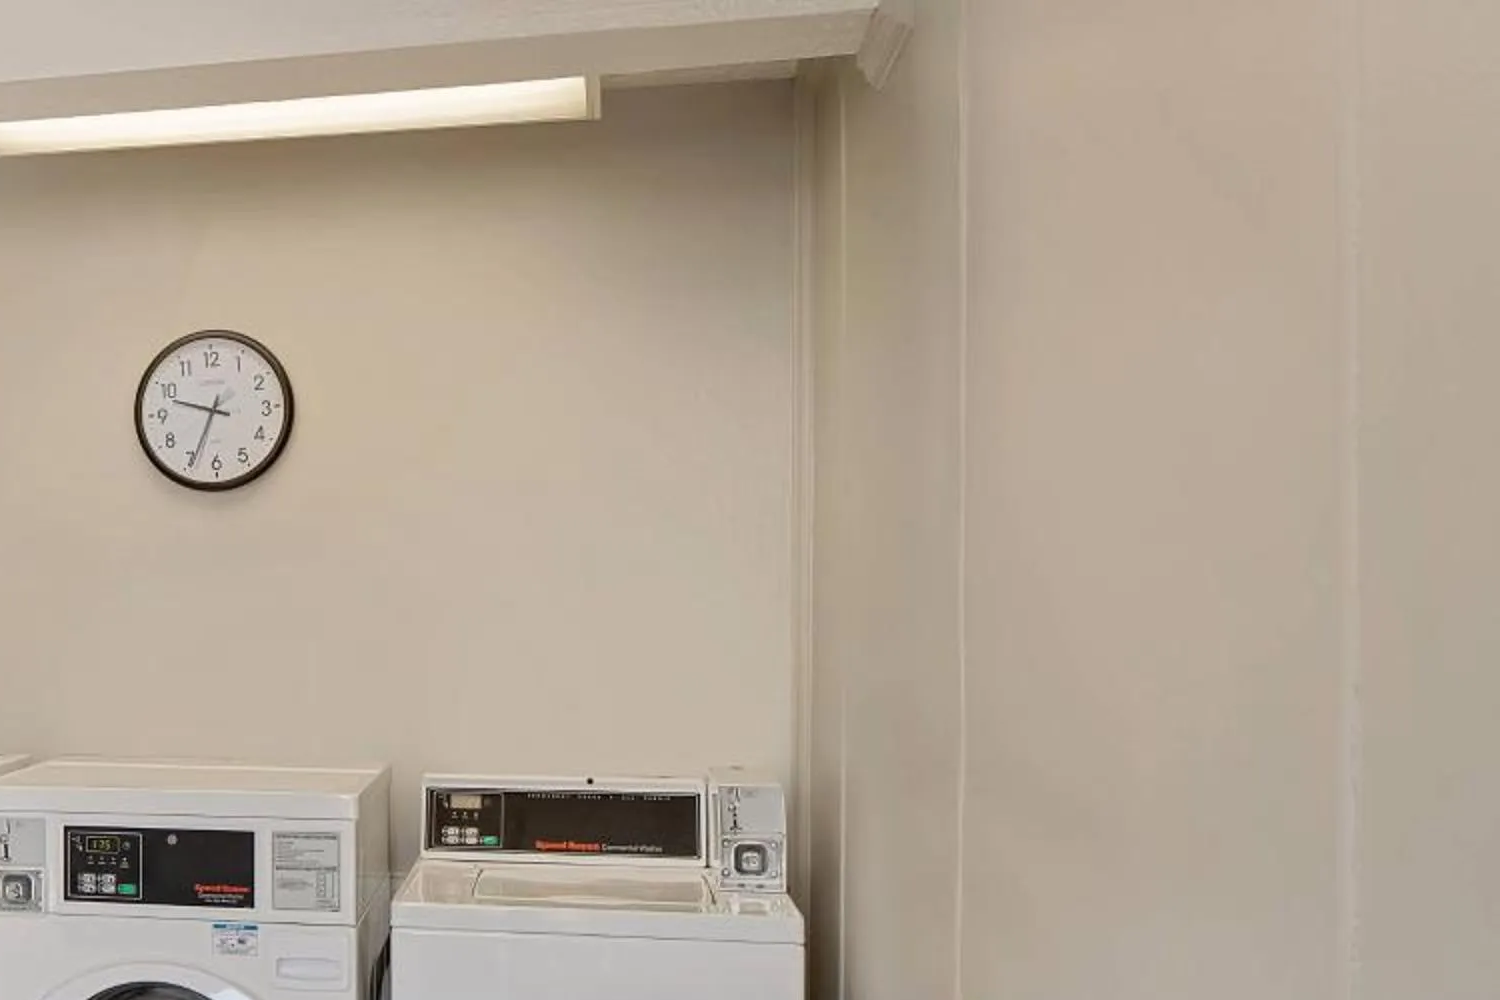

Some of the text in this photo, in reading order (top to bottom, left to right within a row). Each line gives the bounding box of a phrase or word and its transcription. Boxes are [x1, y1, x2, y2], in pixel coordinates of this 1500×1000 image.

[179, 360, 192, 377] 11
[203, 351, 220, 369] 12
[236, 355, 241, 373] 1
[161, 383, 177, 399] 10
[254, 375, 265, 391] 2
[157, 409, 168, 425] 9
[261, 400, 272, 417] 3
[165, 432, 176, 449] 8
[253, 425, 265, 441] 4
[186, 451, 198, 468] 7
[211, 454, 223, 471] 6
[237, 448, 249, 464] 5
